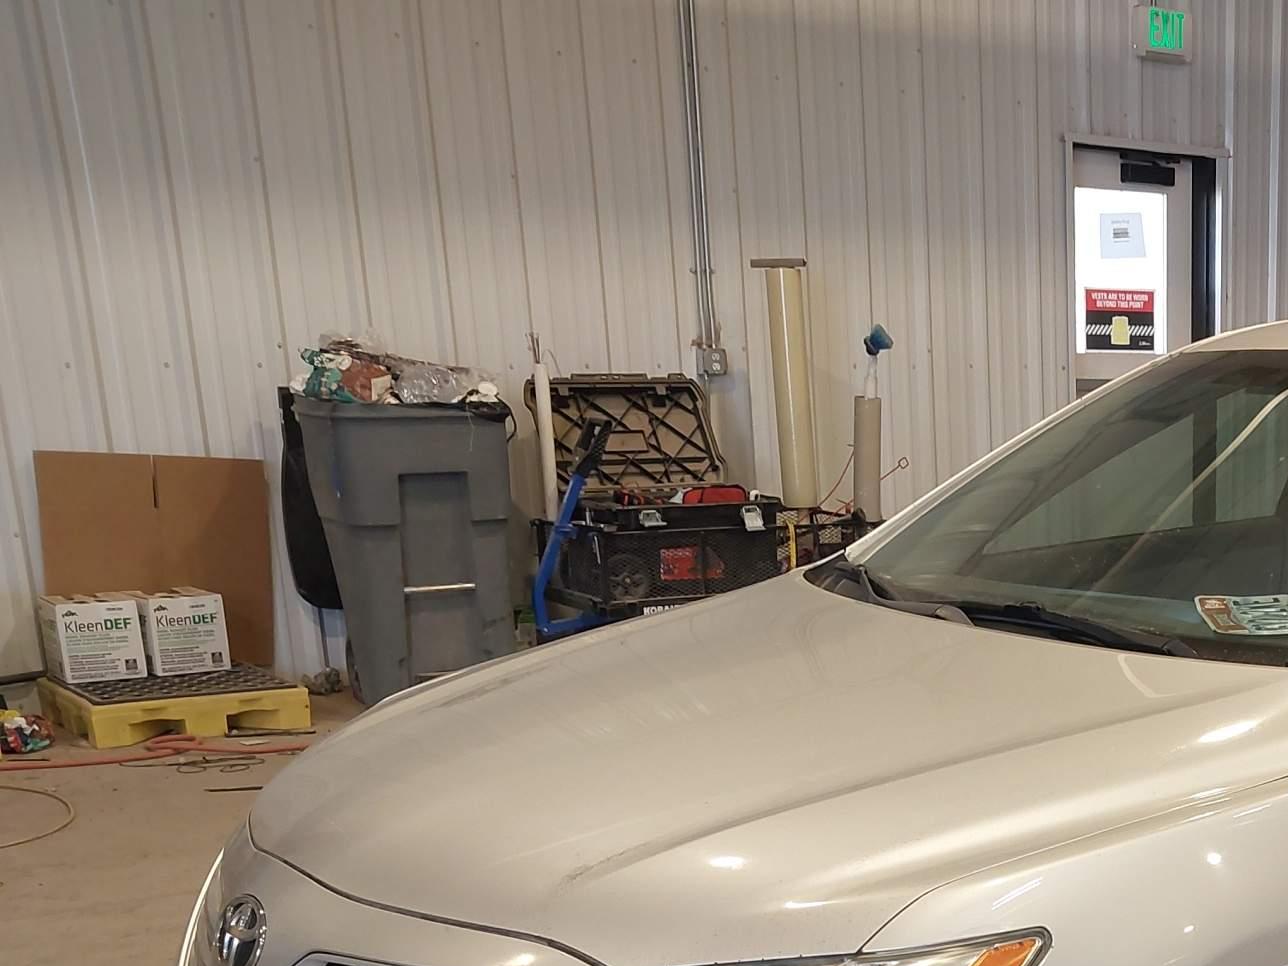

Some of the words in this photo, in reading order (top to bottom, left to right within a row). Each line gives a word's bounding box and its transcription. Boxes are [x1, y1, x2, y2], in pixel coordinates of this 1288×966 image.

[1149, 8, 1184, 49] EXIT
[64, 617, 132, 633] KleenDEF
[156, 612, 217, 627] KleenDEF
